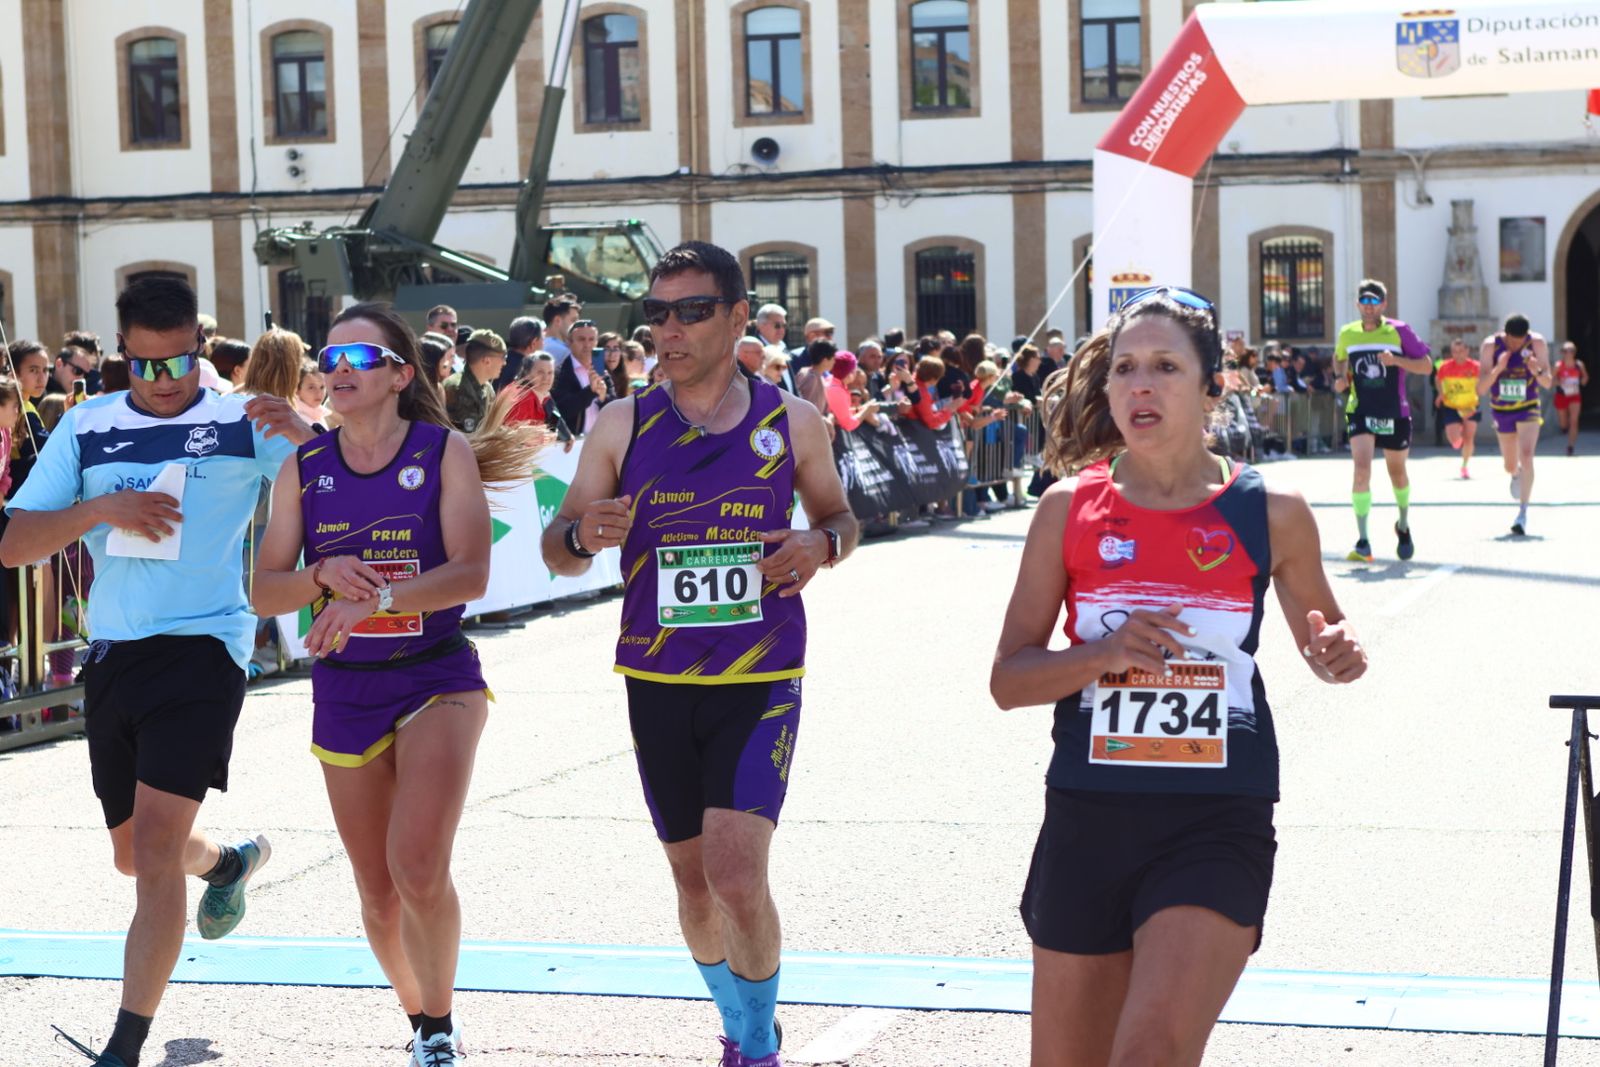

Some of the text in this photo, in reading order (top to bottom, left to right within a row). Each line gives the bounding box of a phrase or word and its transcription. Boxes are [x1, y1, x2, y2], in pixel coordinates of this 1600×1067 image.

[1467, 11, 1599, 36] Diputación
[1467, 45, 1599, 66] de Salaman
[1129, 52, 1203, 146] CON NUESTROS
[1141, 69, 1208, 152] DEPORTISTAS
[185, 466, 207, 480] .L.
[650, 488, 695, 506] Jamón
[719, 502, 765, 520] PRIM
[315, 520, 350, 534] Jamón
[371, 528, 412, 542] PRIM
[661, 526, 763, 544] Atletismo Macoter
[362, 547, 419, 560] Macotera
[686, 556, 736, 566] CARRERA
[674, 567, 748, 604] 610
[1131, 674, 1191, 686] CARRERA
[1101, 690, 1222, 736] 1734
